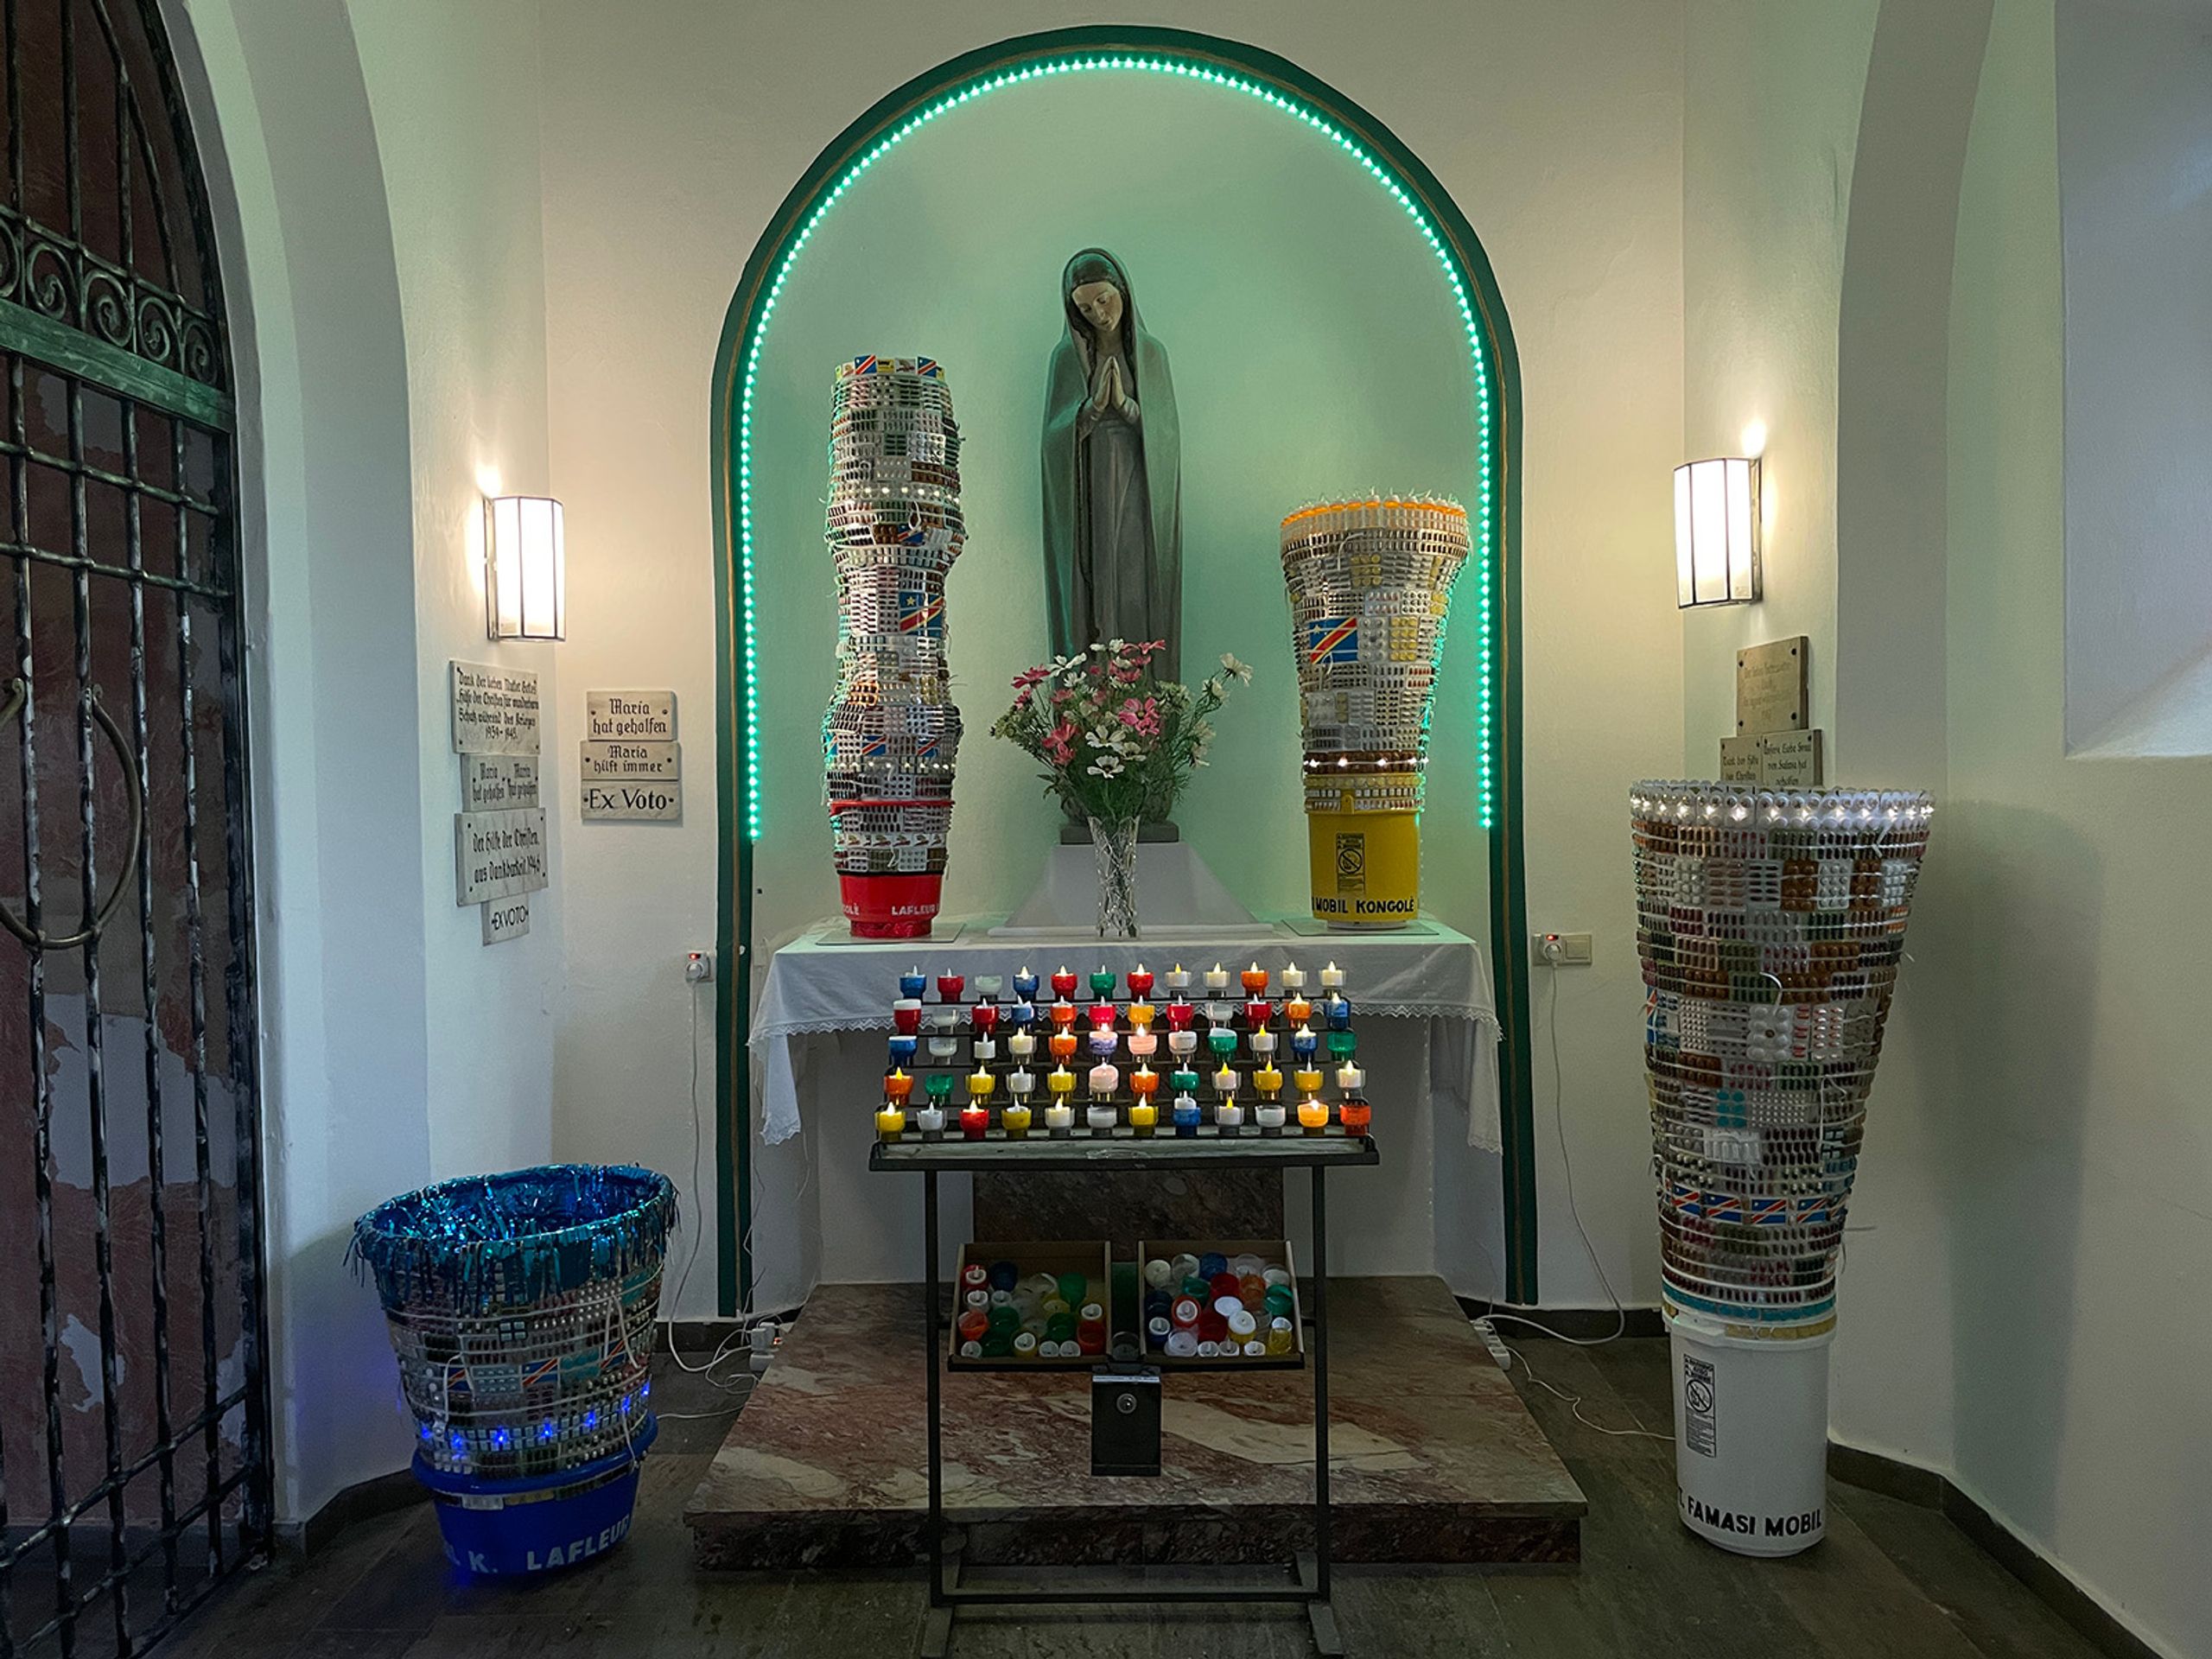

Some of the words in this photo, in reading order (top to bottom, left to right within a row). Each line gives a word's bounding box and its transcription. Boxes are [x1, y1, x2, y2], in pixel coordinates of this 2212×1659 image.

[609, 698, 650, 715] Maria
[593, 718, 613, 734] hat
[616, 717, 667, 736] geholfen
[609, 745, 647, 759] Maria
[594, 760, 618, 774] hilft
[623, 760, 663, 772] immer
[589, 788, 615, 810] Ex
[620, 788, 667, 810] Voto
[1316, 898, 1349, 913] MOBIL
[1688, 1496, 1756, 1535] FAMASI
[1764, 1509, 1822, 1536] MOBIL
[527, 1513, 630, 1571] LAFLEUR
